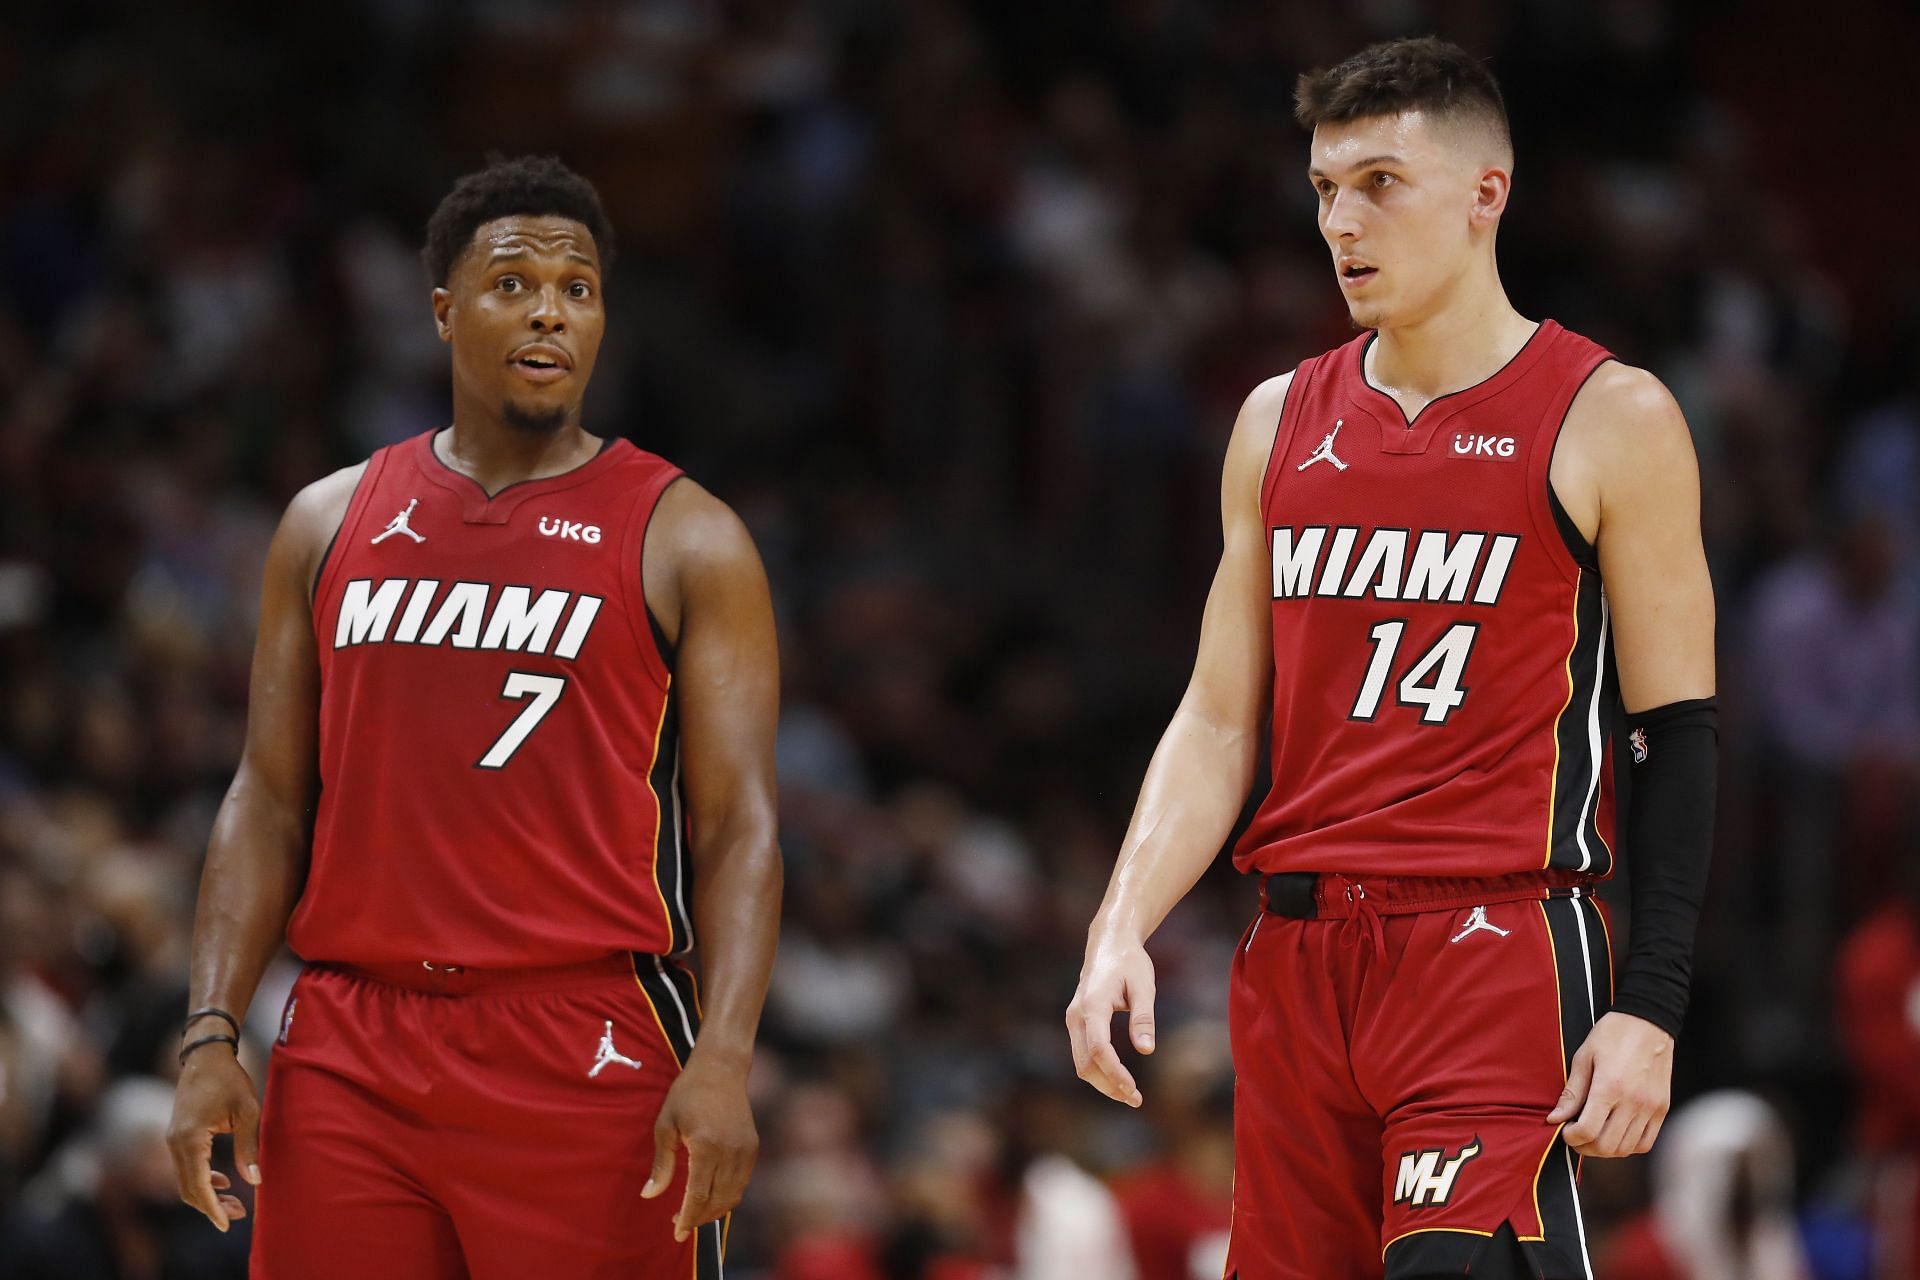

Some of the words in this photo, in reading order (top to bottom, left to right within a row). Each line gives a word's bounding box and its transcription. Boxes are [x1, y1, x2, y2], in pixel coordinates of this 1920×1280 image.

[1272, 526, 1521, 606] MIAMI
[333, 577, 604, 662] MIAMI
[1347, 619, 1481, 726] 14
[474, 669, 568, 771] 7
